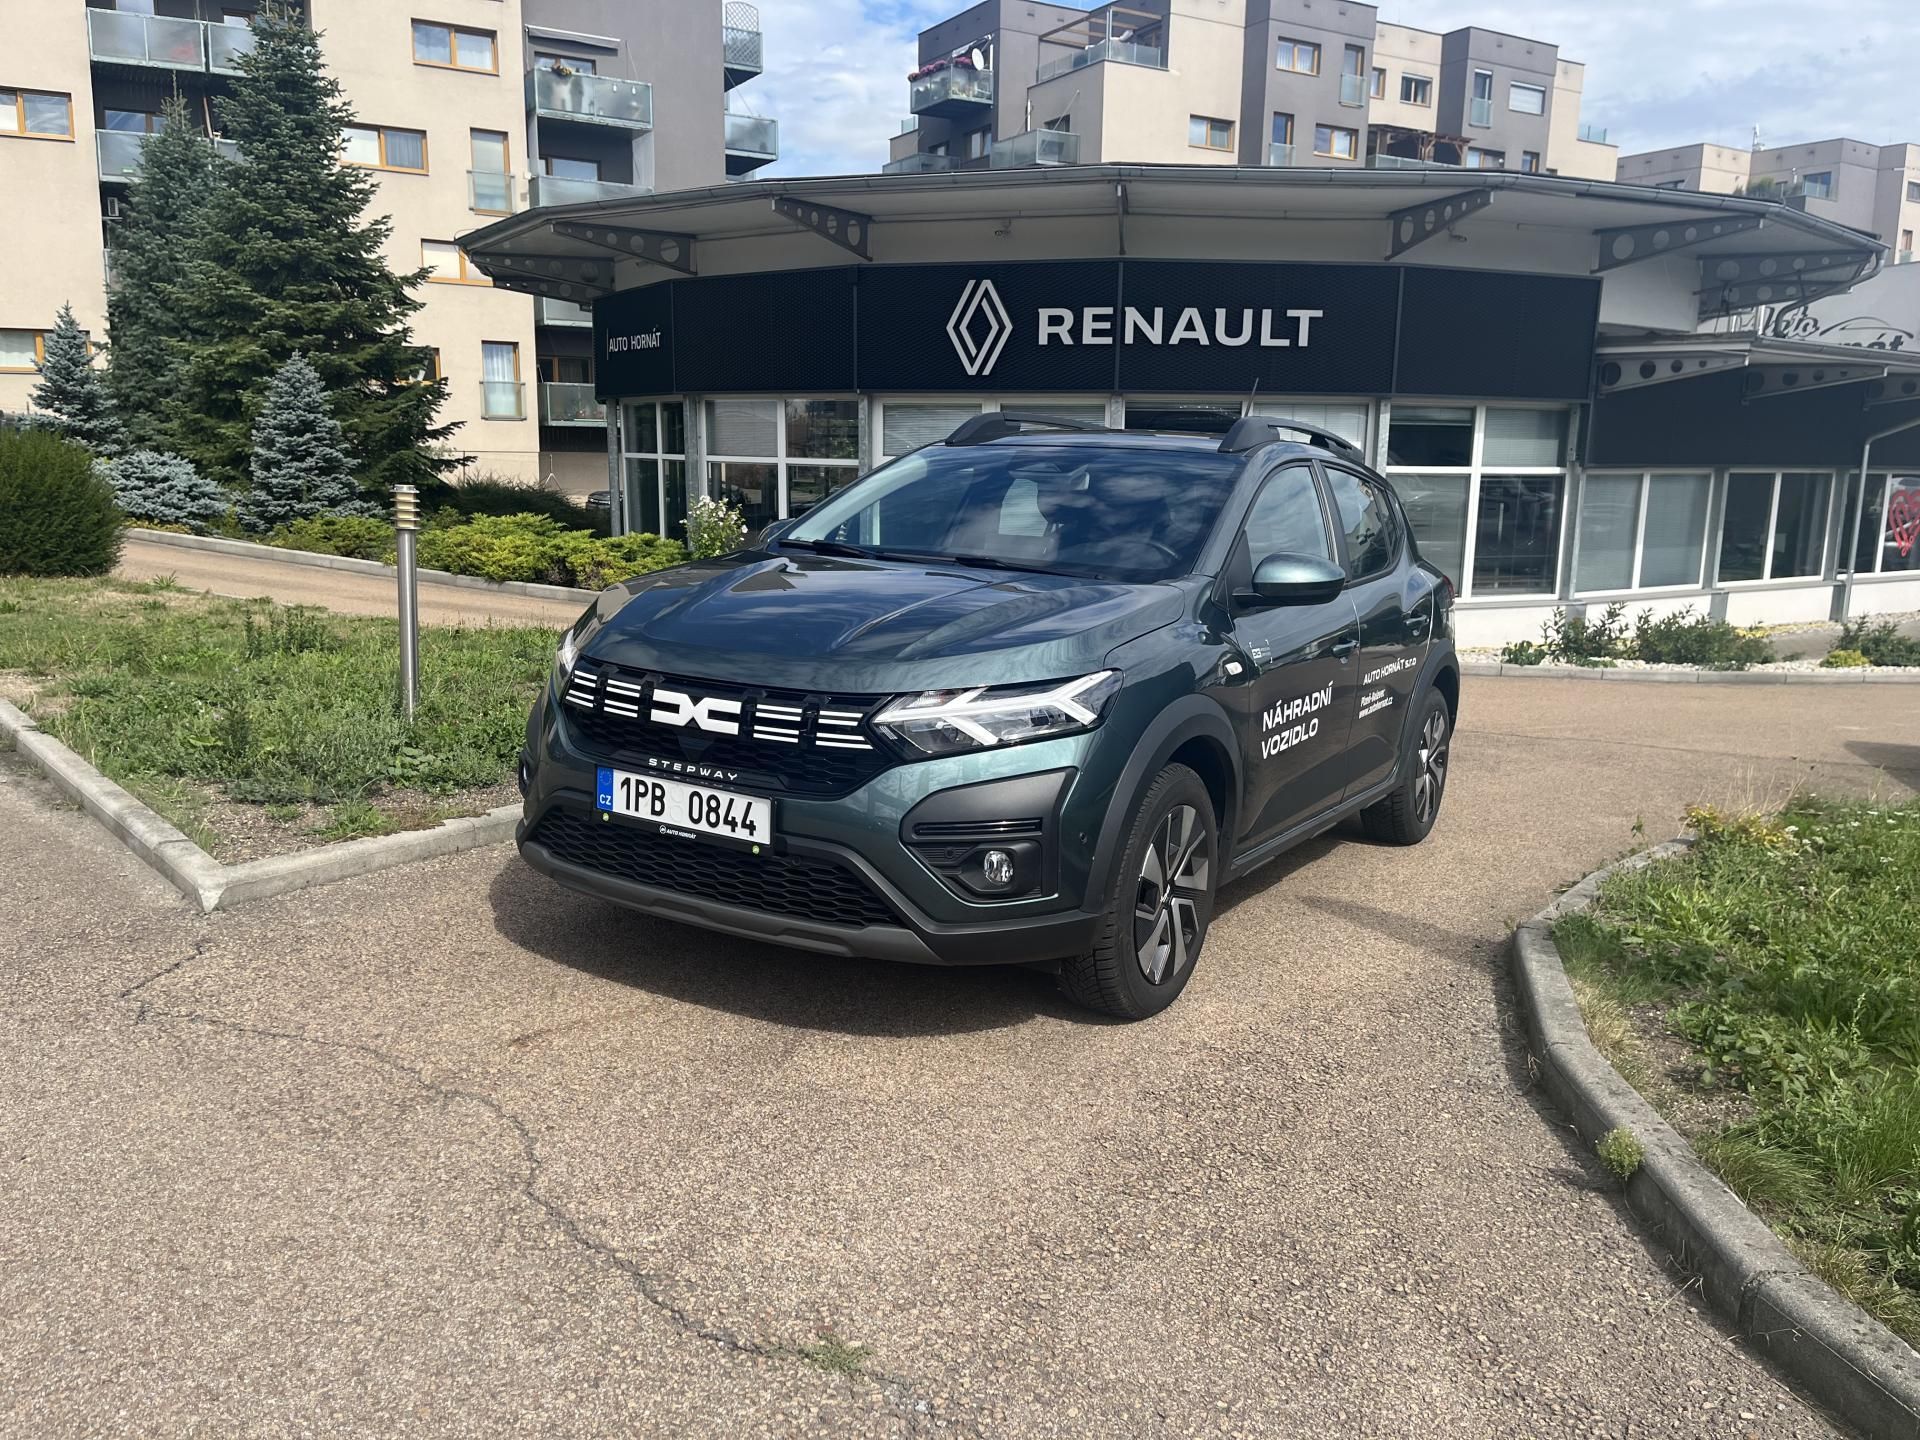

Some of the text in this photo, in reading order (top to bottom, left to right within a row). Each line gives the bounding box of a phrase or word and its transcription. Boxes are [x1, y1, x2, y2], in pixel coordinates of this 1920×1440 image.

[609, 327, 661, 352] AUTO HORNÁT
[1037, 306, 1324, 347] RENAULT
[1363, 669, 1381, 686] AUTO
[1380, 658, 1405, 678] HORNÁT
[1262, 680, 1334, 732] NÁHRADNÍ
[1261, 718, 1319, 760] VOZIDLO
[648, 758, 738, 781] STEPWAY
[599, 793, 612, 806] CZ
[620, 777, 757, 837] 1PB 0844
